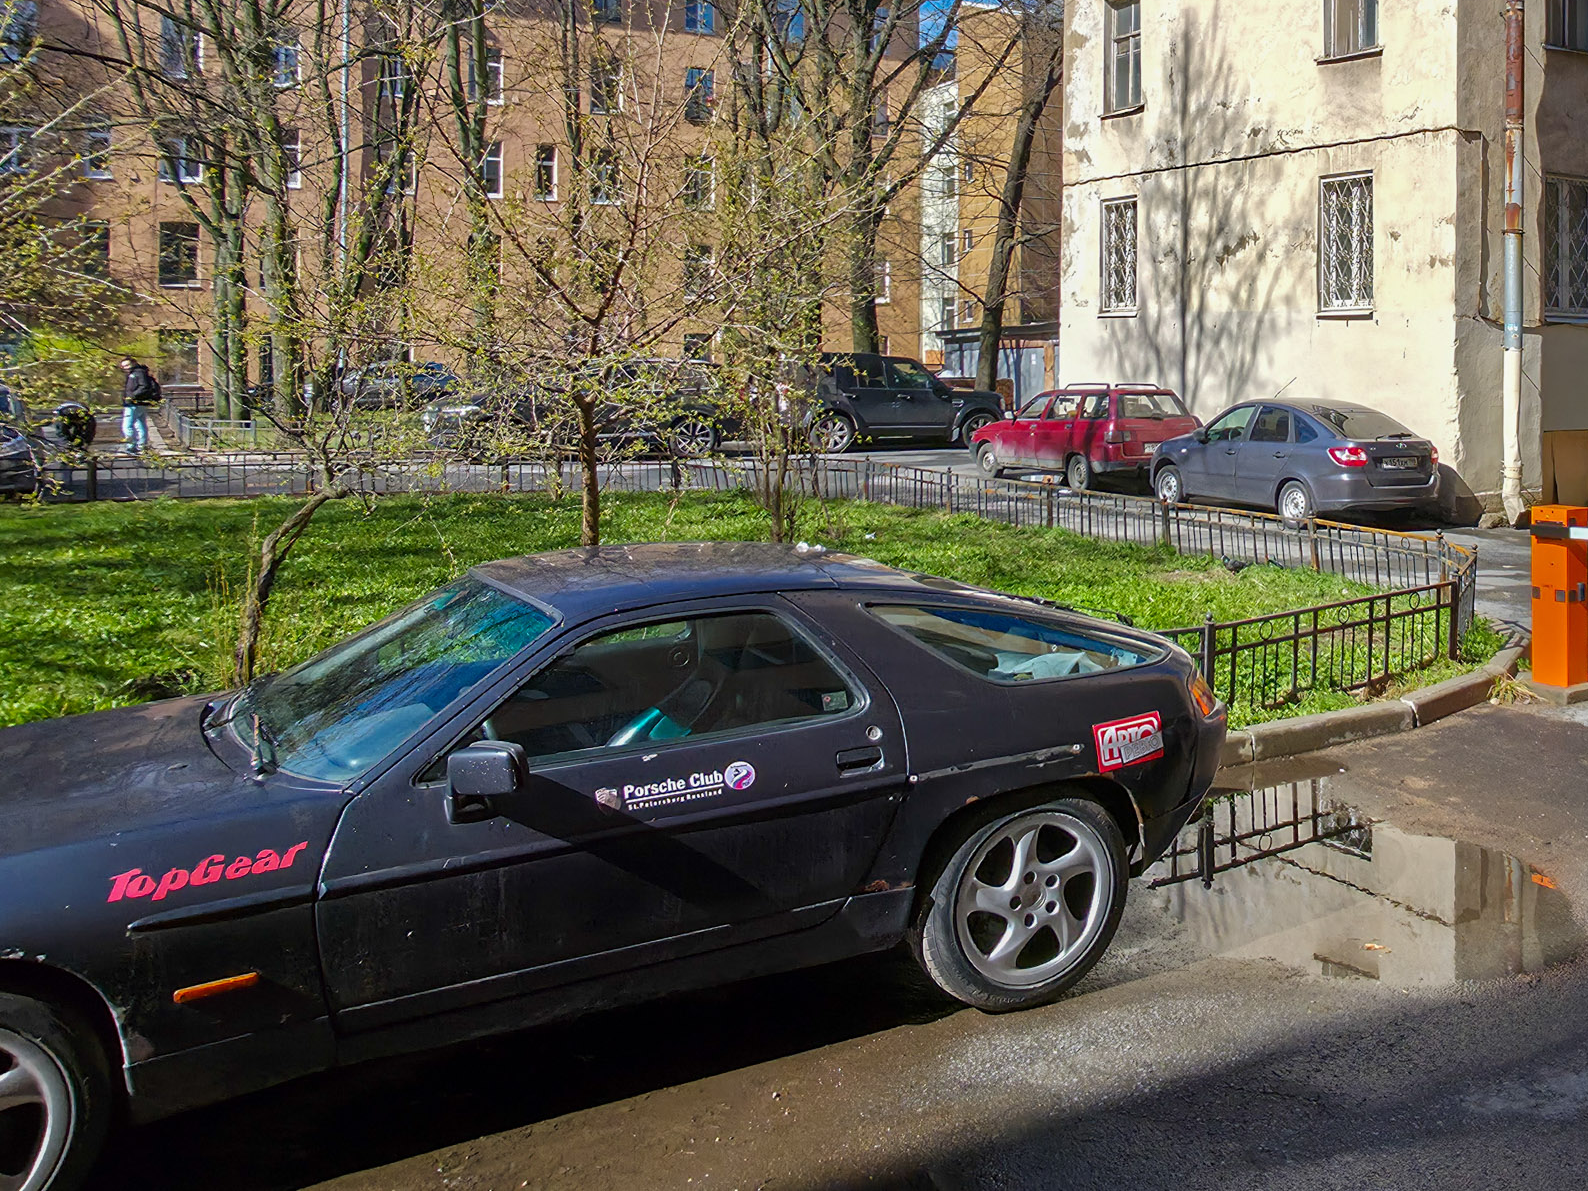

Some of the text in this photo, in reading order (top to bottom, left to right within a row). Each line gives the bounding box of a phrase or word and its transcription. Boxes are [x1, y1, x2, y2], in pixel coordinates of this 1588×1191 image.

[623, 770, 724, 800] Porsche Club
[107, 840, 309, 903] TopGear
